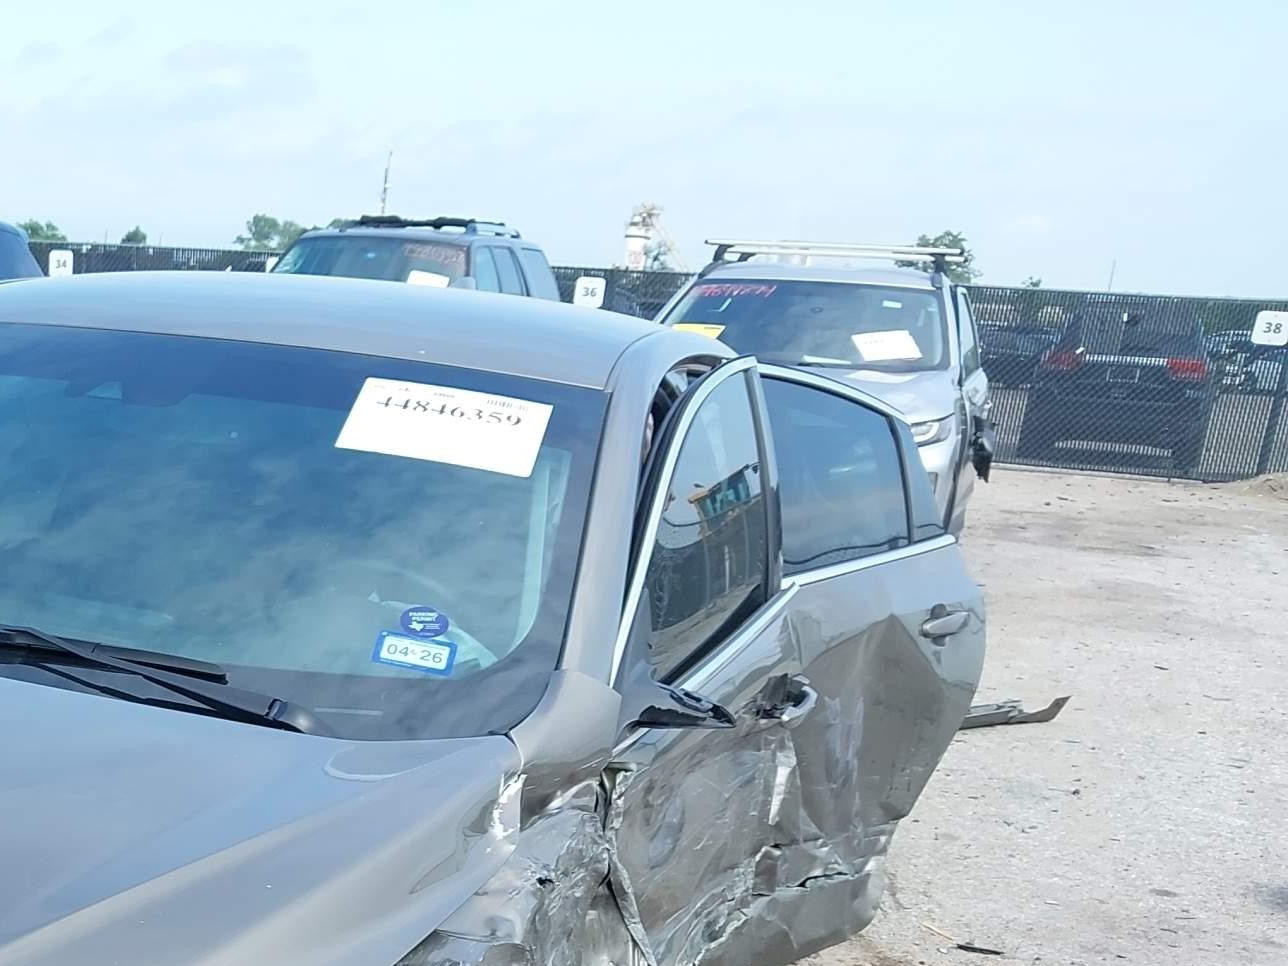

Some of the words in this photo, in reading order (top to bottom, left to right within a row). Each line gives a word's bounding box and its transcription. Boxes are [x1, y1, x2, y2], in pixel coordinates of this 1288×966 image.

[55, 259, 68, 269] 34
[582, 286, 598, 297] 36
[1263, 322, 1283, 334] 38
[376, 396, 522, 425] 44846359
